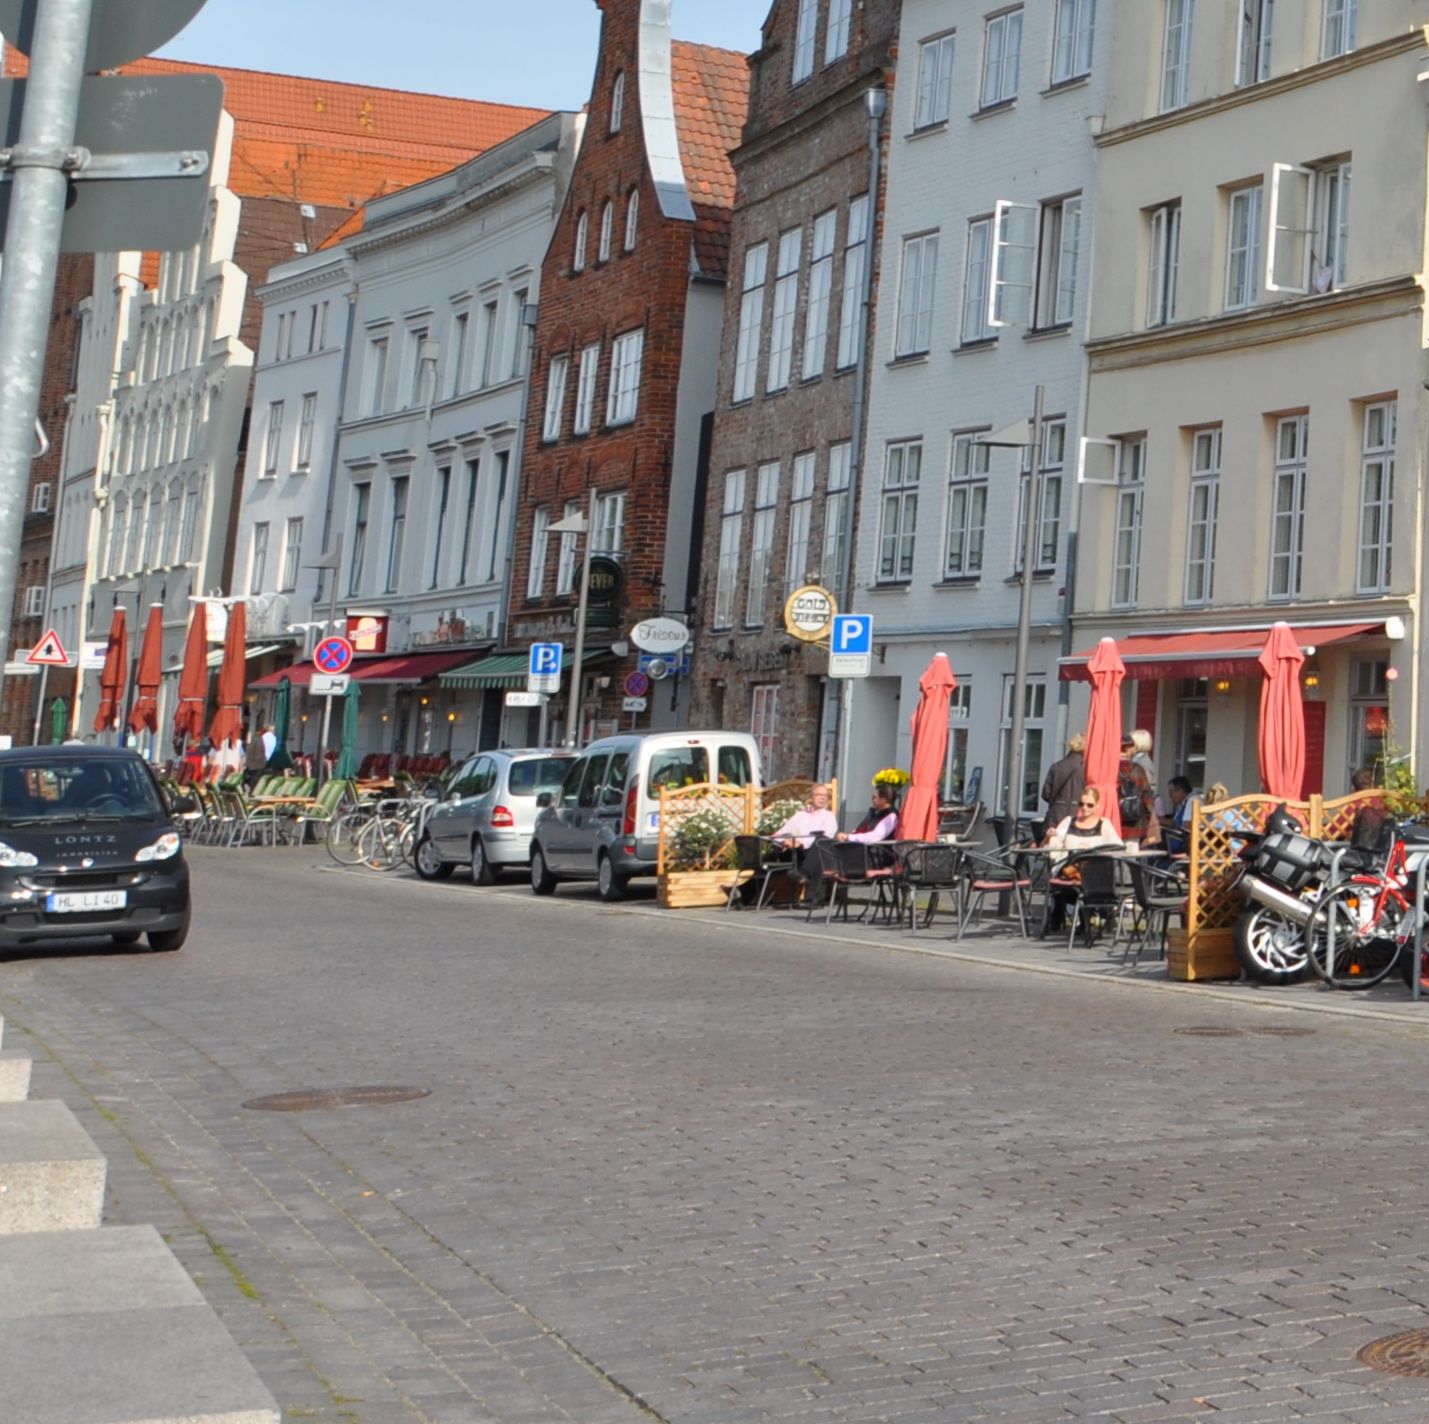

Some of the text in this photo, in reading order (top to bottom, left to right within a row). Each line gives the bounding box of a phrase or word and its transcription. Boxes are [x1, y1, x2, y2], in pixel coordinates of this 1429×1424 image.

[590, 573, 614, 589] EVER
[840, 619, 864, 650] P
[537, 647, 555, 671] P
[55, 835, 116, 845] LONTZ
